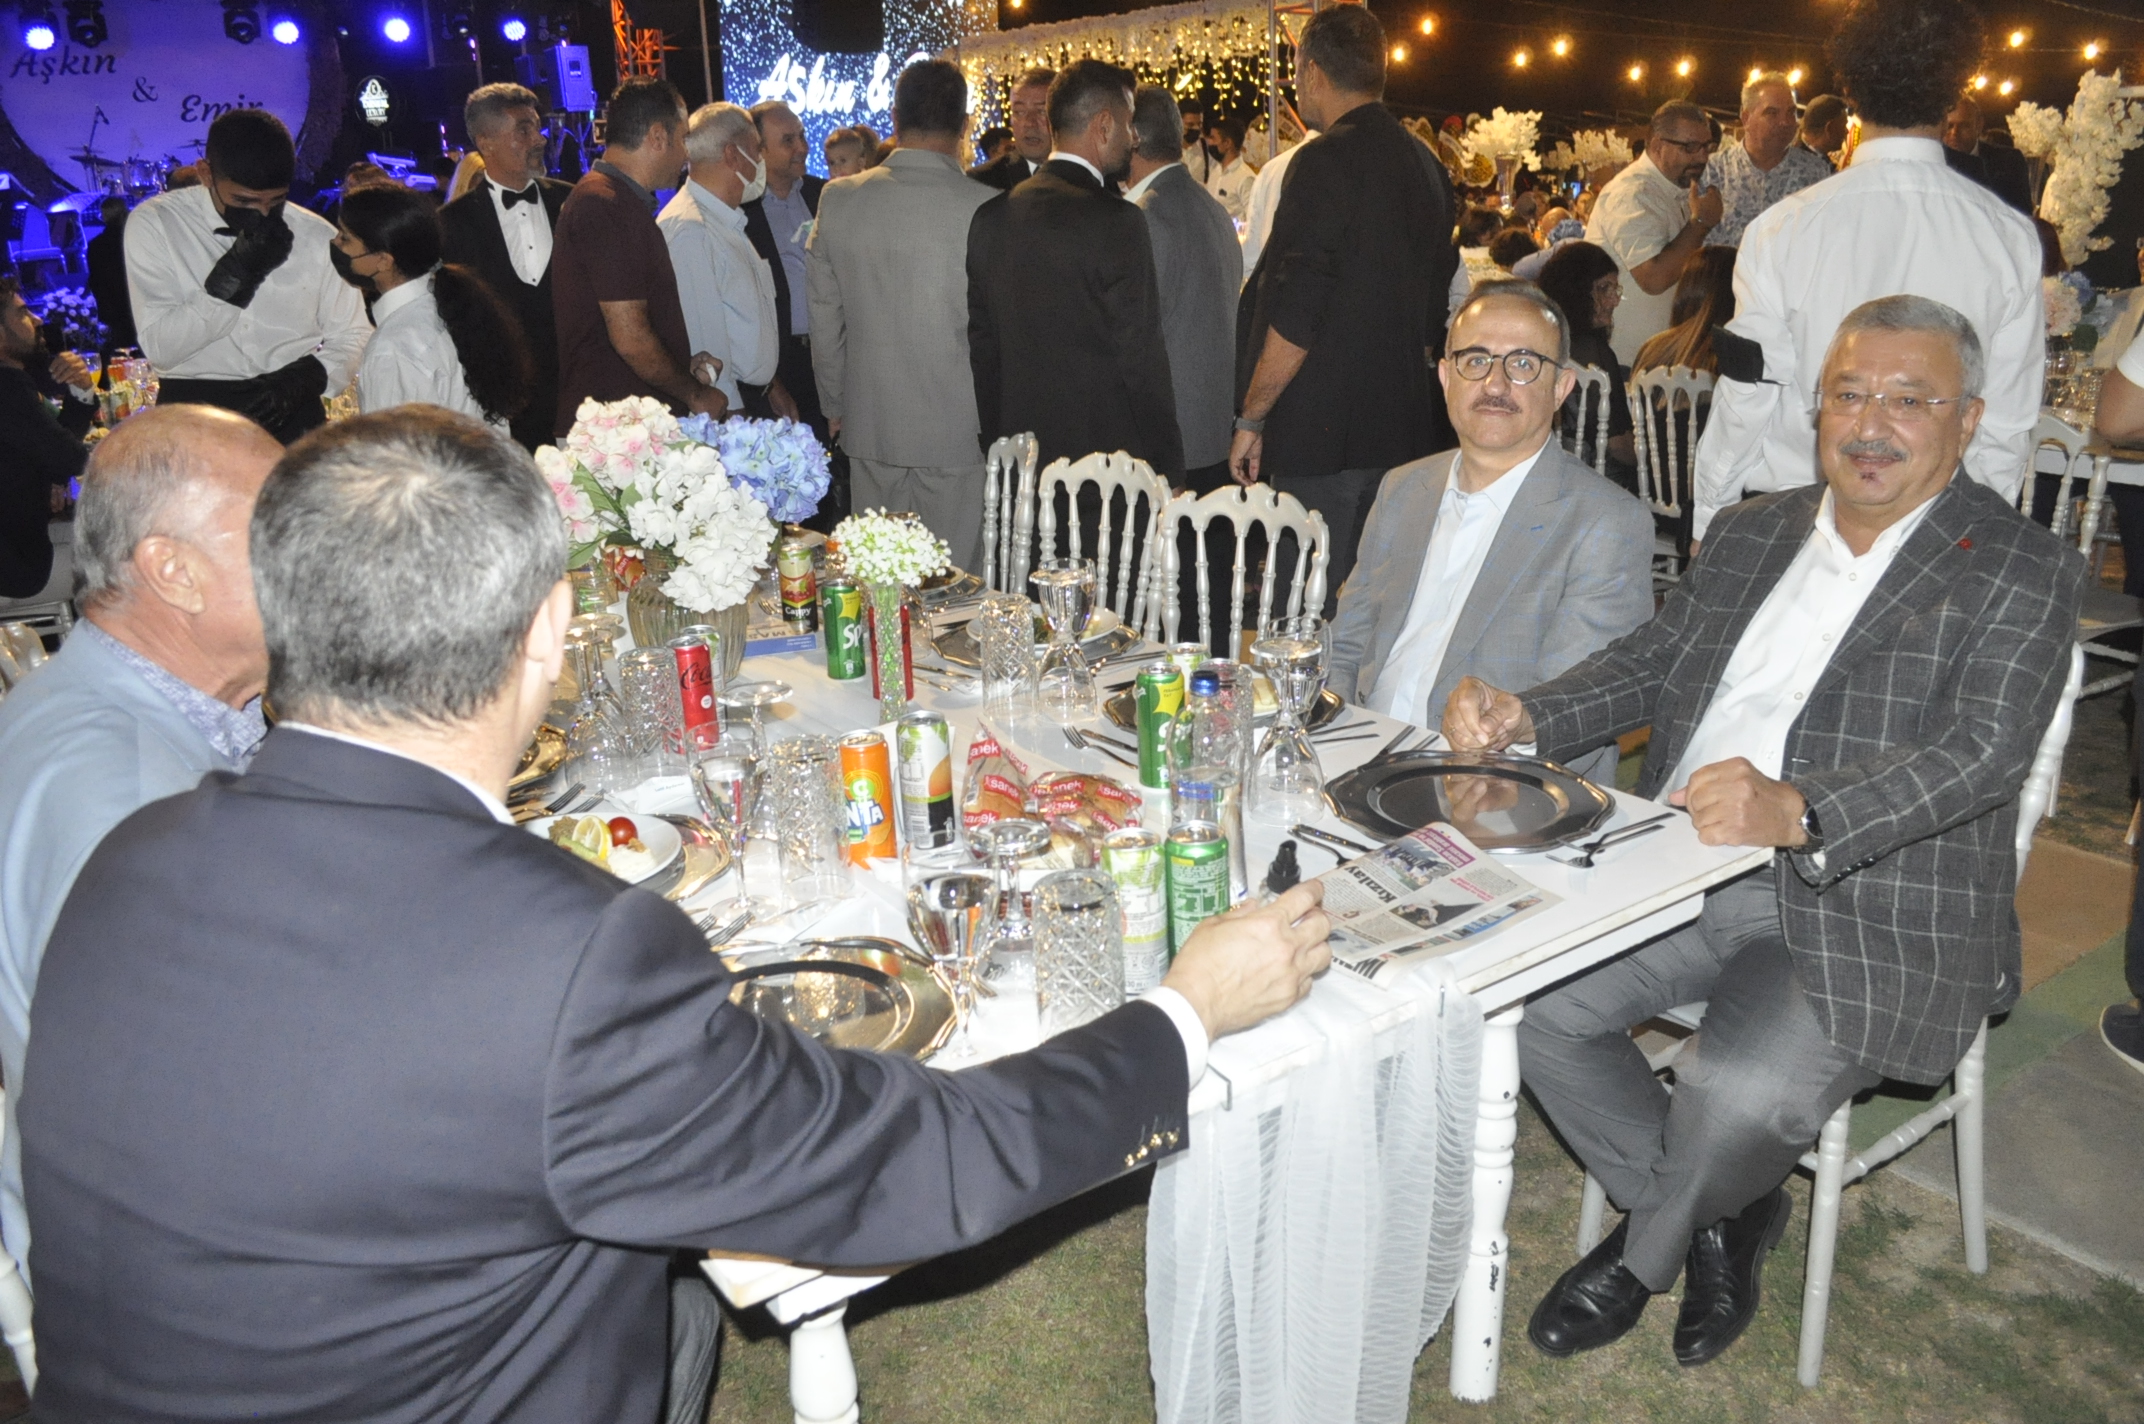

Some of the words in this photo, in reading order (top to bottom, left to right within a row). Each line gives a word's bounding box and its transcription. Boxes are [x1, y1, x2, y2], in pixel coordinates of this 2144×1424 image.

[9, 45, 116, 85] Aşkın
[132, 76, 158, 102] &
[785, 607, 811, 619] Cappy
[846, 799, 884, 827] NTA
[1343, 866, 1397, 903] Kızılay
